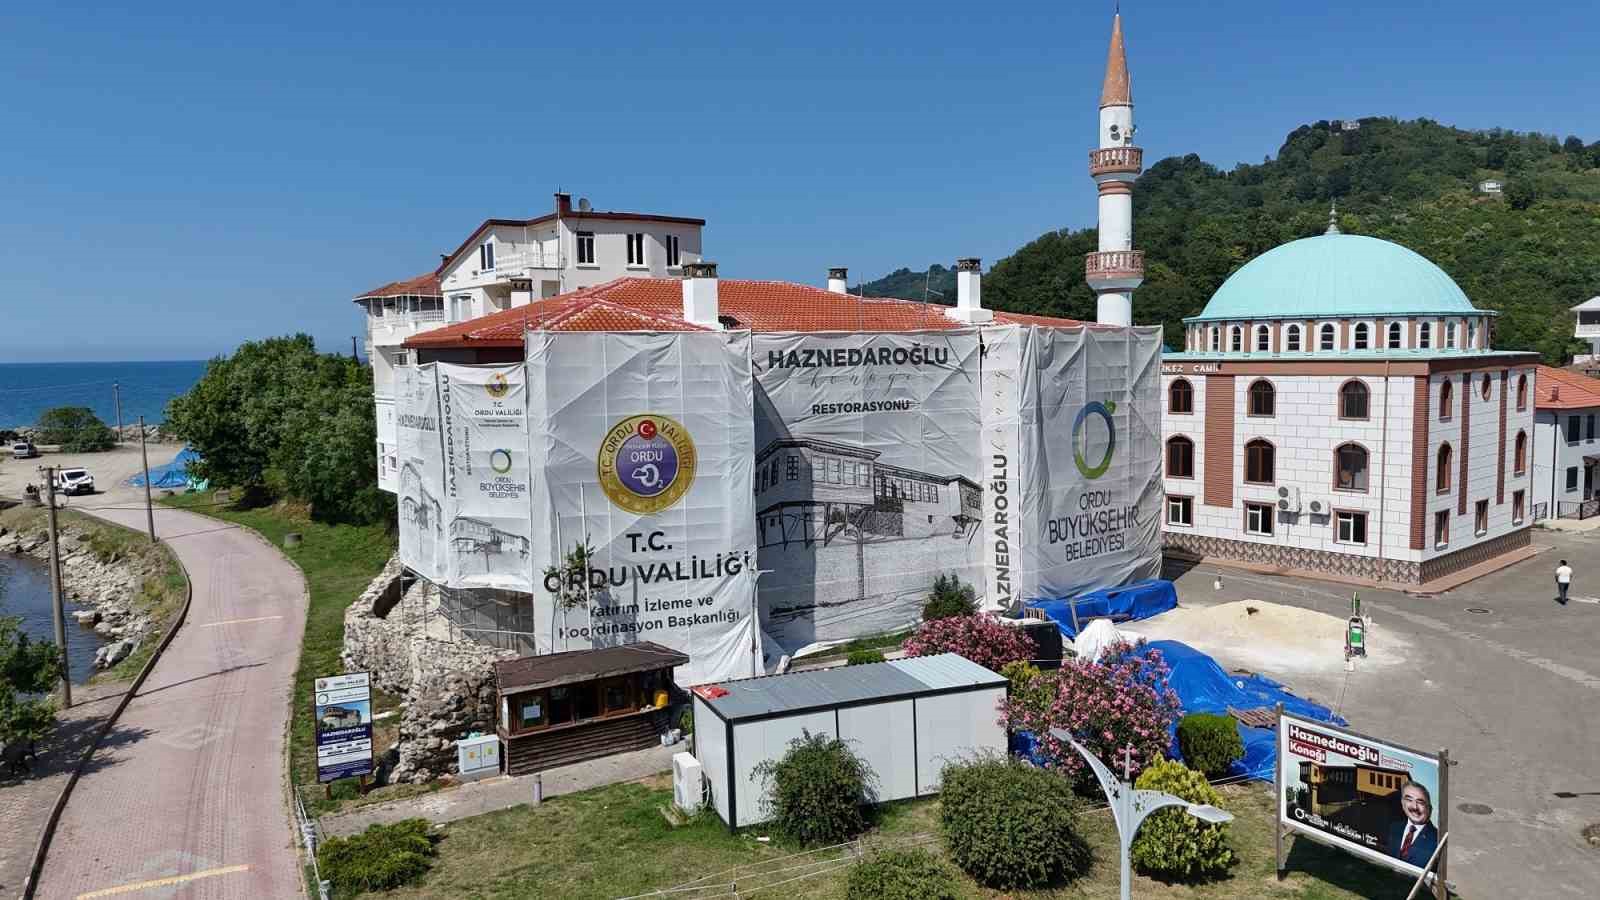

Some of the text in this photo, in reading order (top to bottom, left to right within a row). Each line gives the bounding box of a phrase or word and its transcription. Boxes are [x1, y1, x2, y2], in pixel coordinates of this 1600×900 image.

[768, 343, 948, 369] HAZNEDAROĞLU
[812, 400, 910, 415] RESTORASYONU
[631, 450, 664, 463] ORDU
[1079, 488, 1112, 511] ORDU
[990, 453, 1012, 611] AZNEDAROĞLU
[1048, 503, 1140, 544] BÜYÜKŞEHİR
[626, 531, 673, 553] T.C.
[1065, 532, 1126, 562] BELEDİYESİ
[543, 550, 750, 593] ORDU VALİLİĞİ
[644, 598, 693, 613] İzleme
[697, 596, 714, 607] ve
[668, 608, 741, 628] Başkanlığı
[1290, 725, 1378, 762] Haznedaroğlu
[1290, 741, 1325, 761] Konağı
